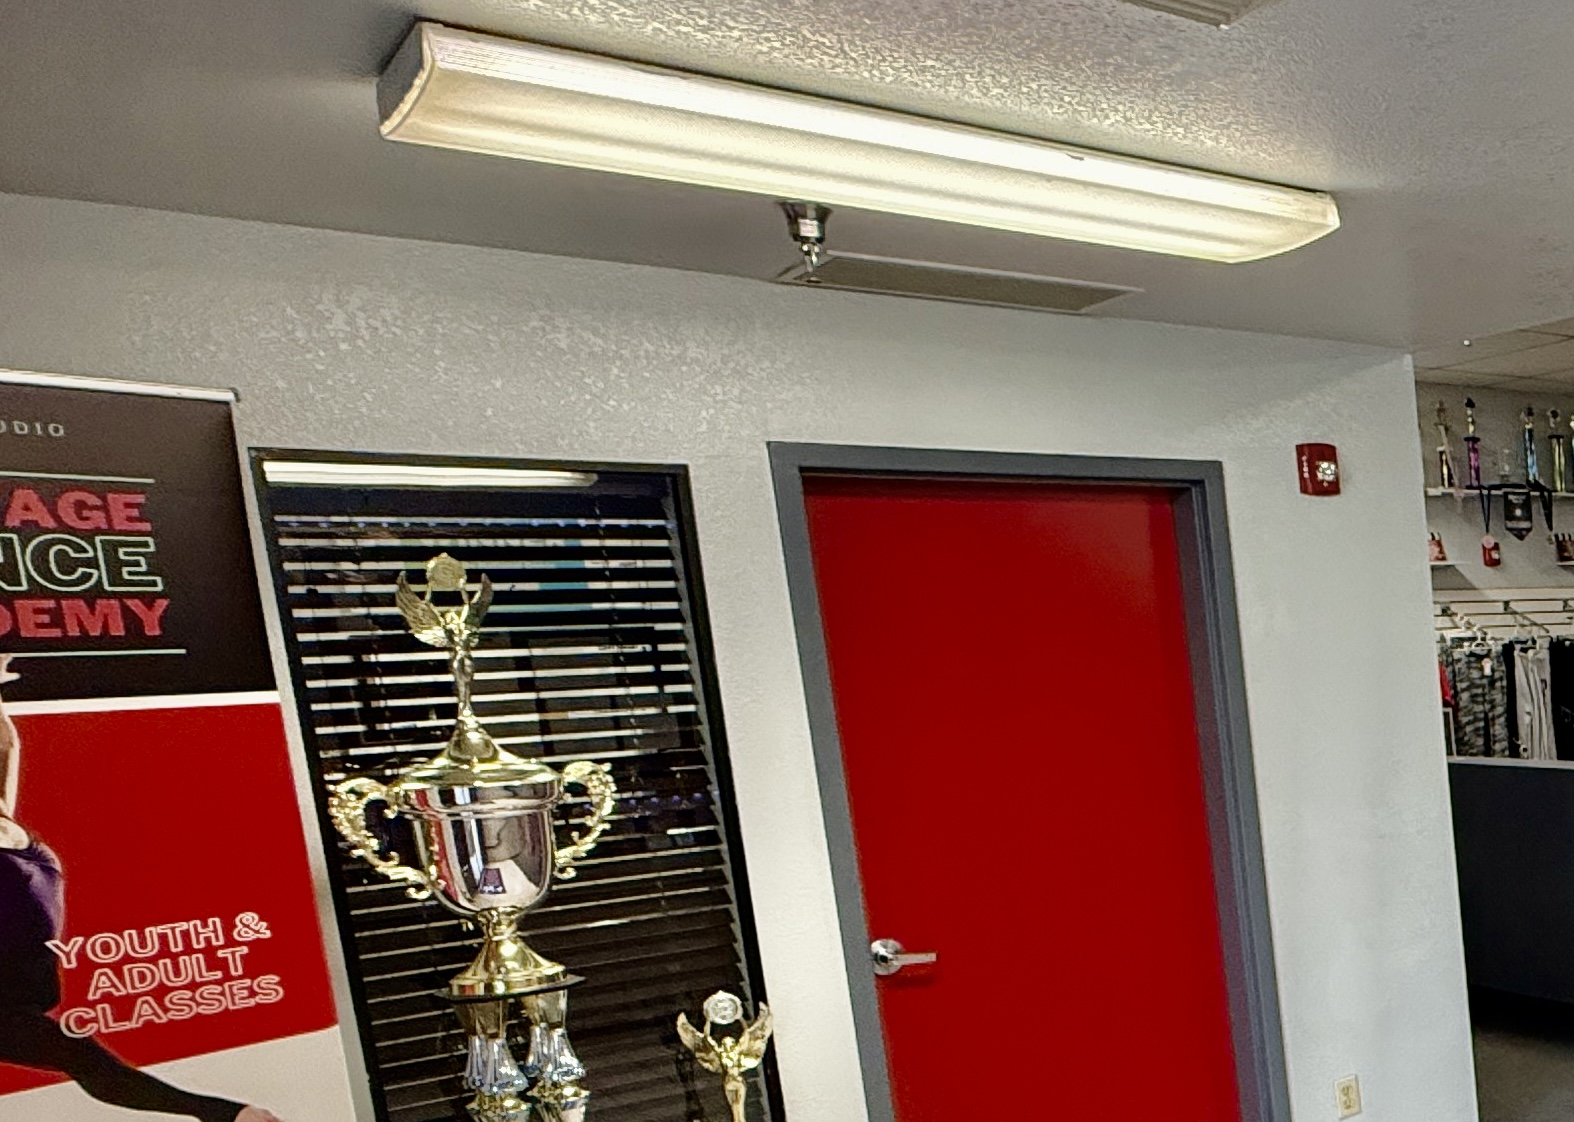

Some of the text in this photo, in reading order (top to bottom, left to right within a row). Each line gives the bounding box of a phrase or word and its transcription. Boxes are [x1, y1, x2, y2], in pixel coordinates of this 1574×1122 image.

[45, 911, 272, 969] YOUTH &
[86, 945, 250, 1001] ADULT
[58, 974, 284, 1039] CLASSES
